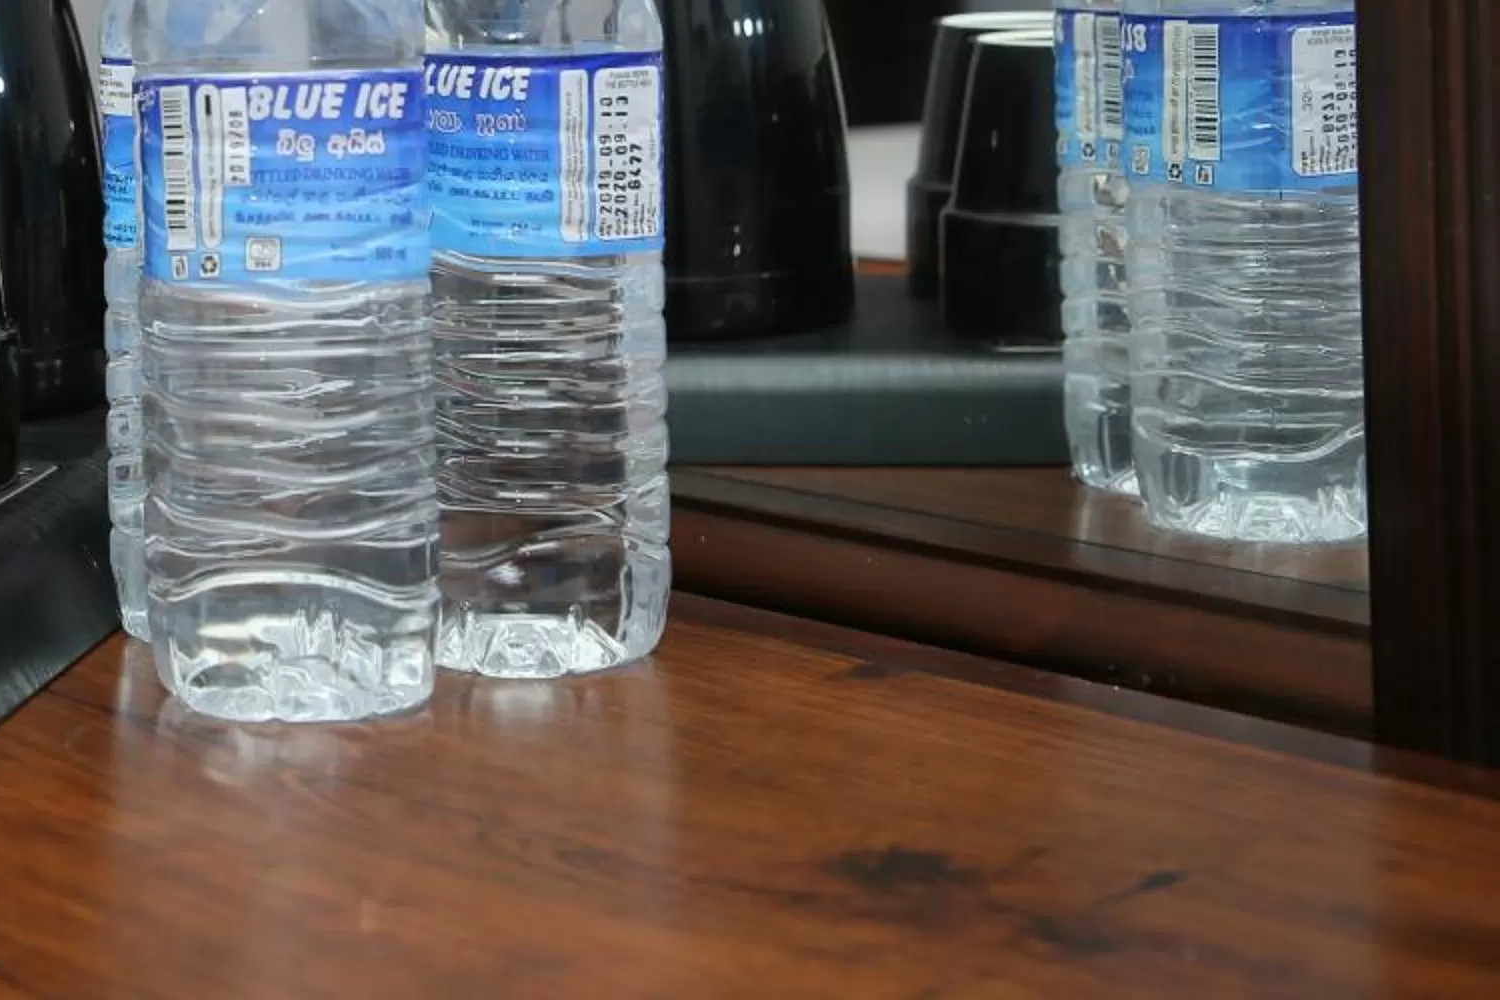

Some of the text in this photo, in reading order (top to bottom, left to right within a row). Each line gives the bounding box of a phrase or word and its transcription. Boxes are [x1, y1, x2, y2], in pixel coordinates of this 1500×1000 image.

[422, 62, 532, 101] LUE ICE
[249, 82, 408, 121] BLUE ICE
